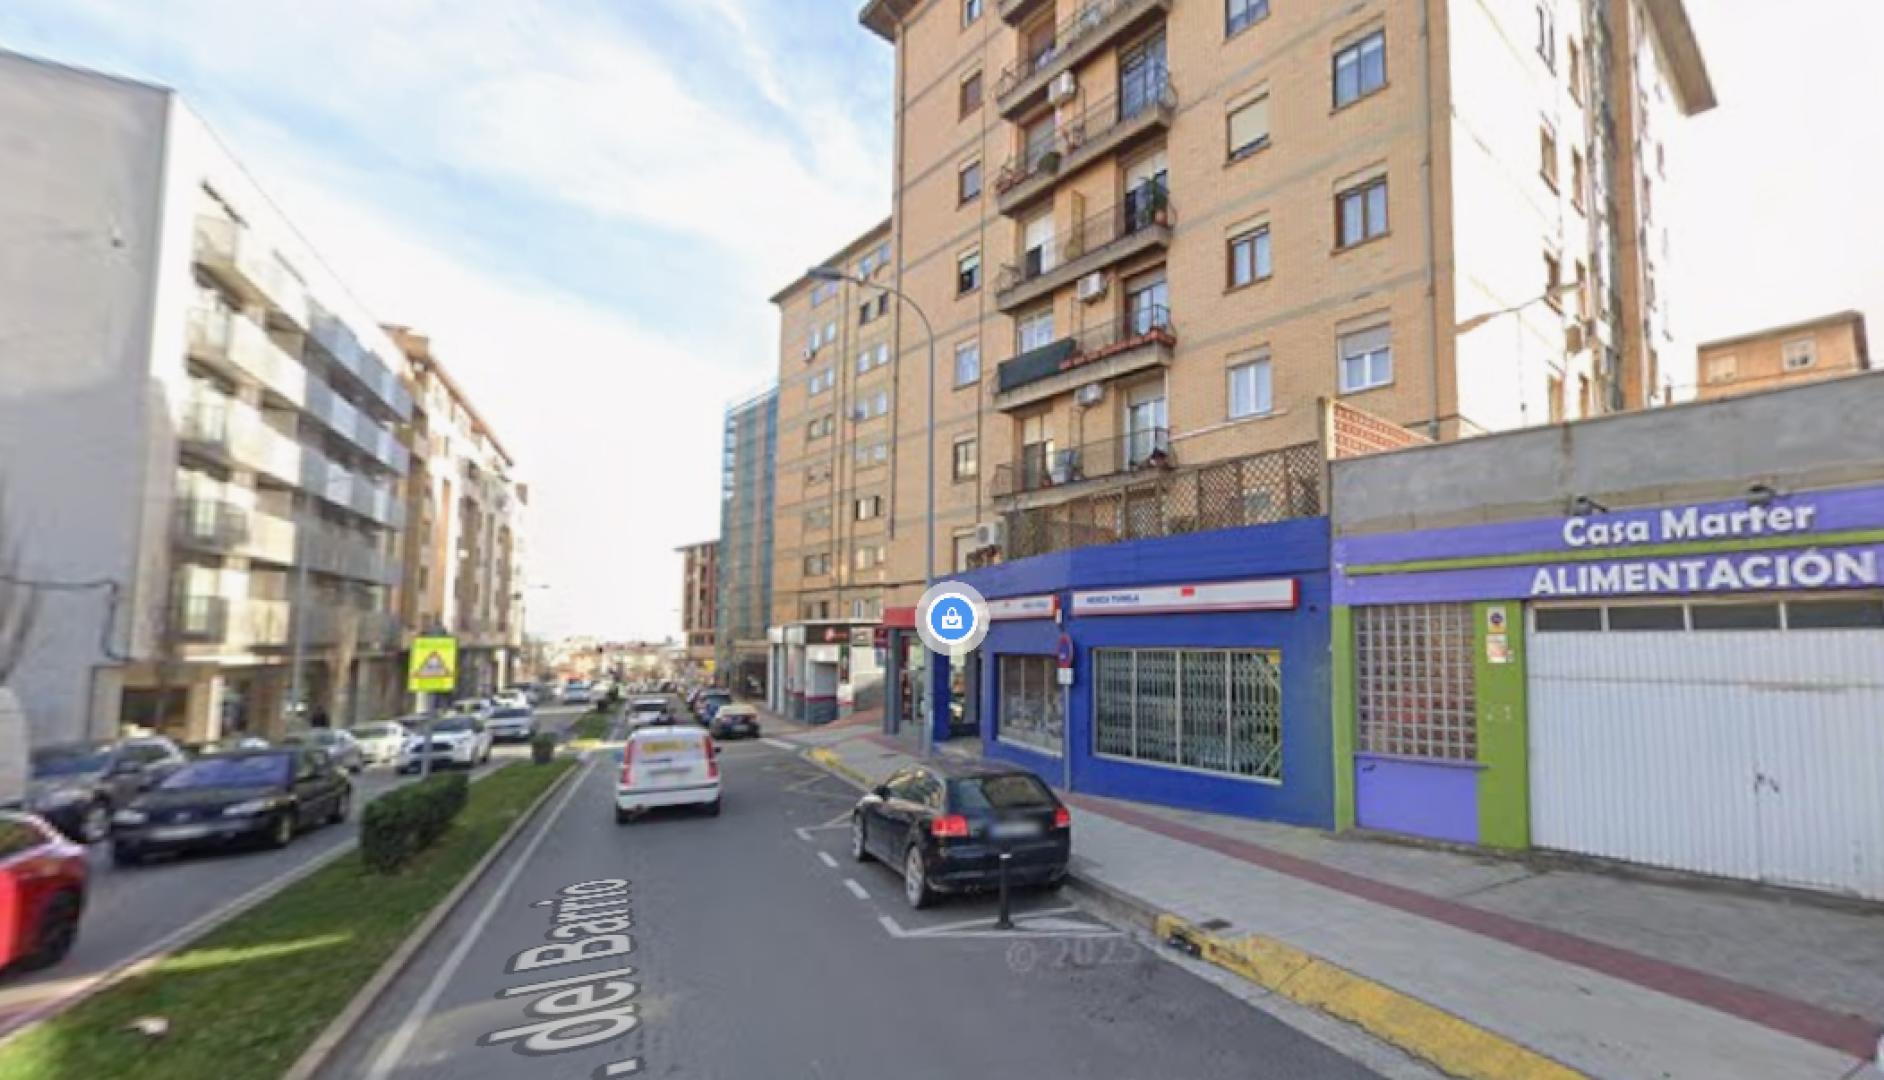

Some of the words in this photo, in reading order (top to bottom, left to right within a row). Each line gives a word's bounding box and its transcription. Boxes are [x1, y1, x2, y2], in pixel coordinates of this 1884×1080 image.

[1563, 518, 1649, 546] Casa
[1661, 504, 1816, 539] Marter
[1531, 547, 1878, 595] ALIMENTACIÓN
